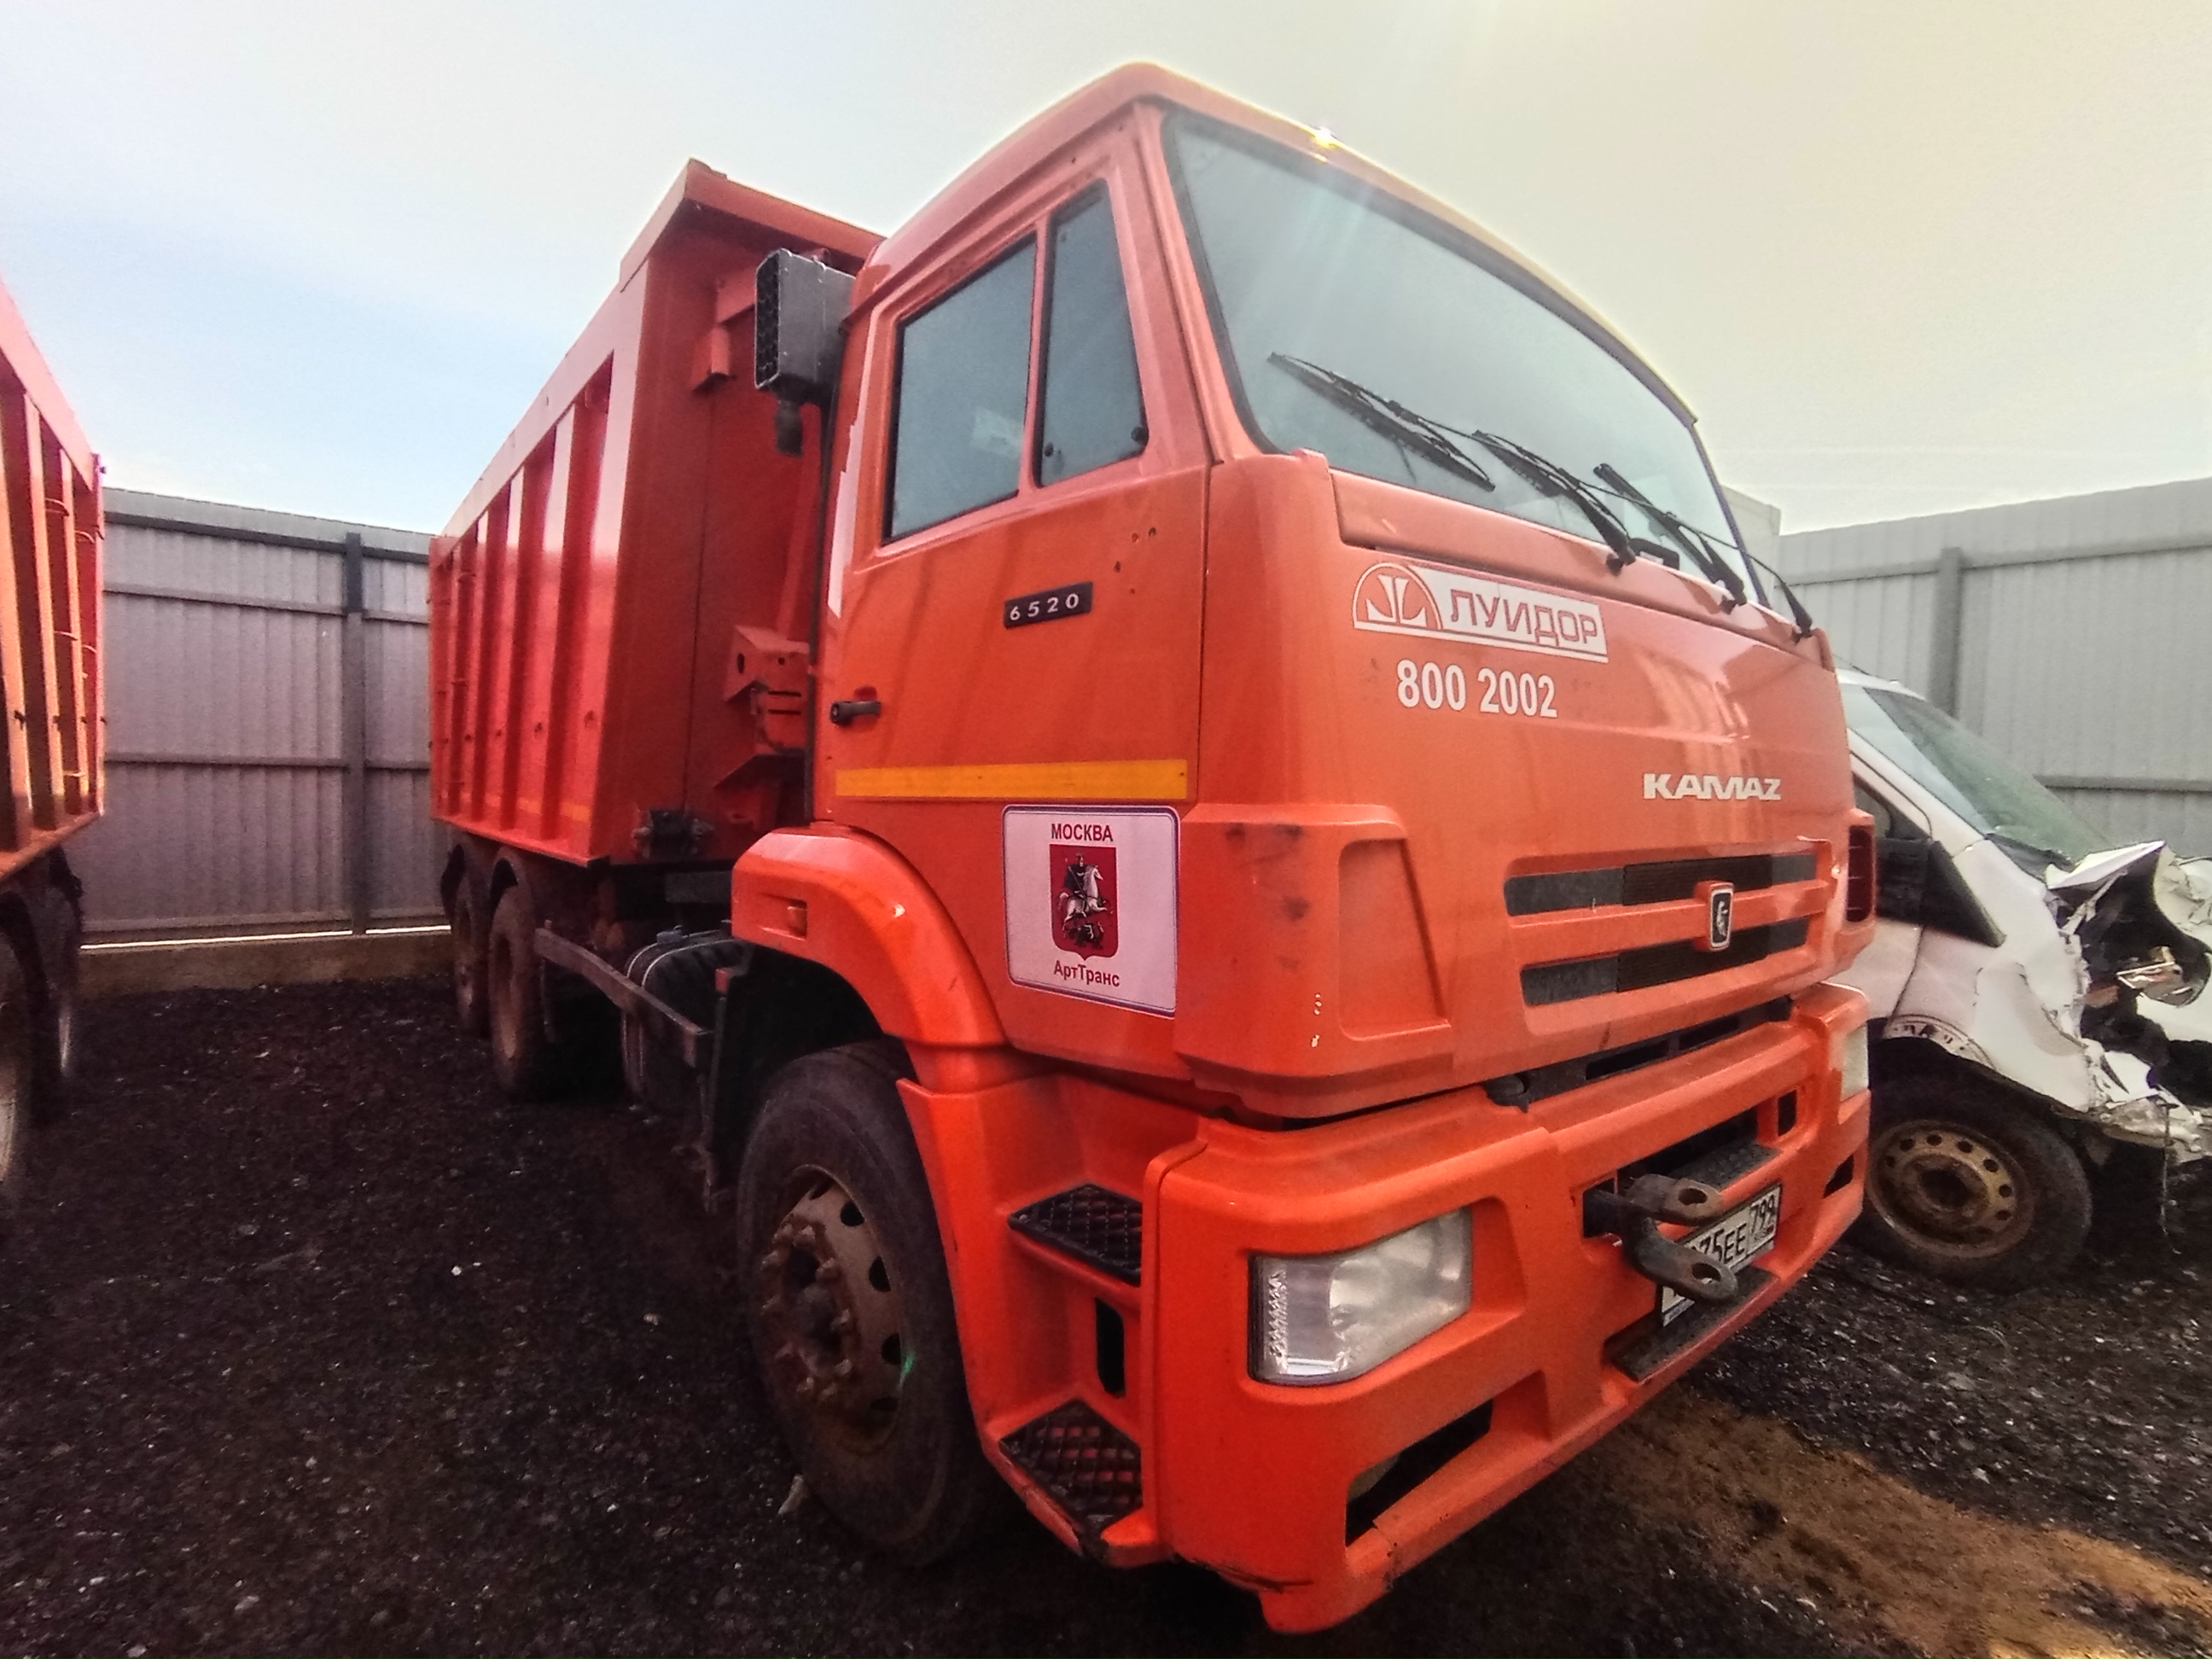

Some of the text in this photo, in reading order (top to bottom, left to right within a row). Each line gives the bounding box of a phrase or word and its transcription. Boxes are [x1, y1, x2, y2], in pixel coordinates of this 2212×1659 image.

[1010, 592, 1080, 621] 6520
[1450, 588, 1598, 646] ЛУИДОР
[1397, 659, 1558, 718] 800 2002
[1643, 773, 1782, 800] KAMAZ
[1051, 823, 1114, 842] МОСКВА
[1053, 959, 1121, 987] АртТранс
